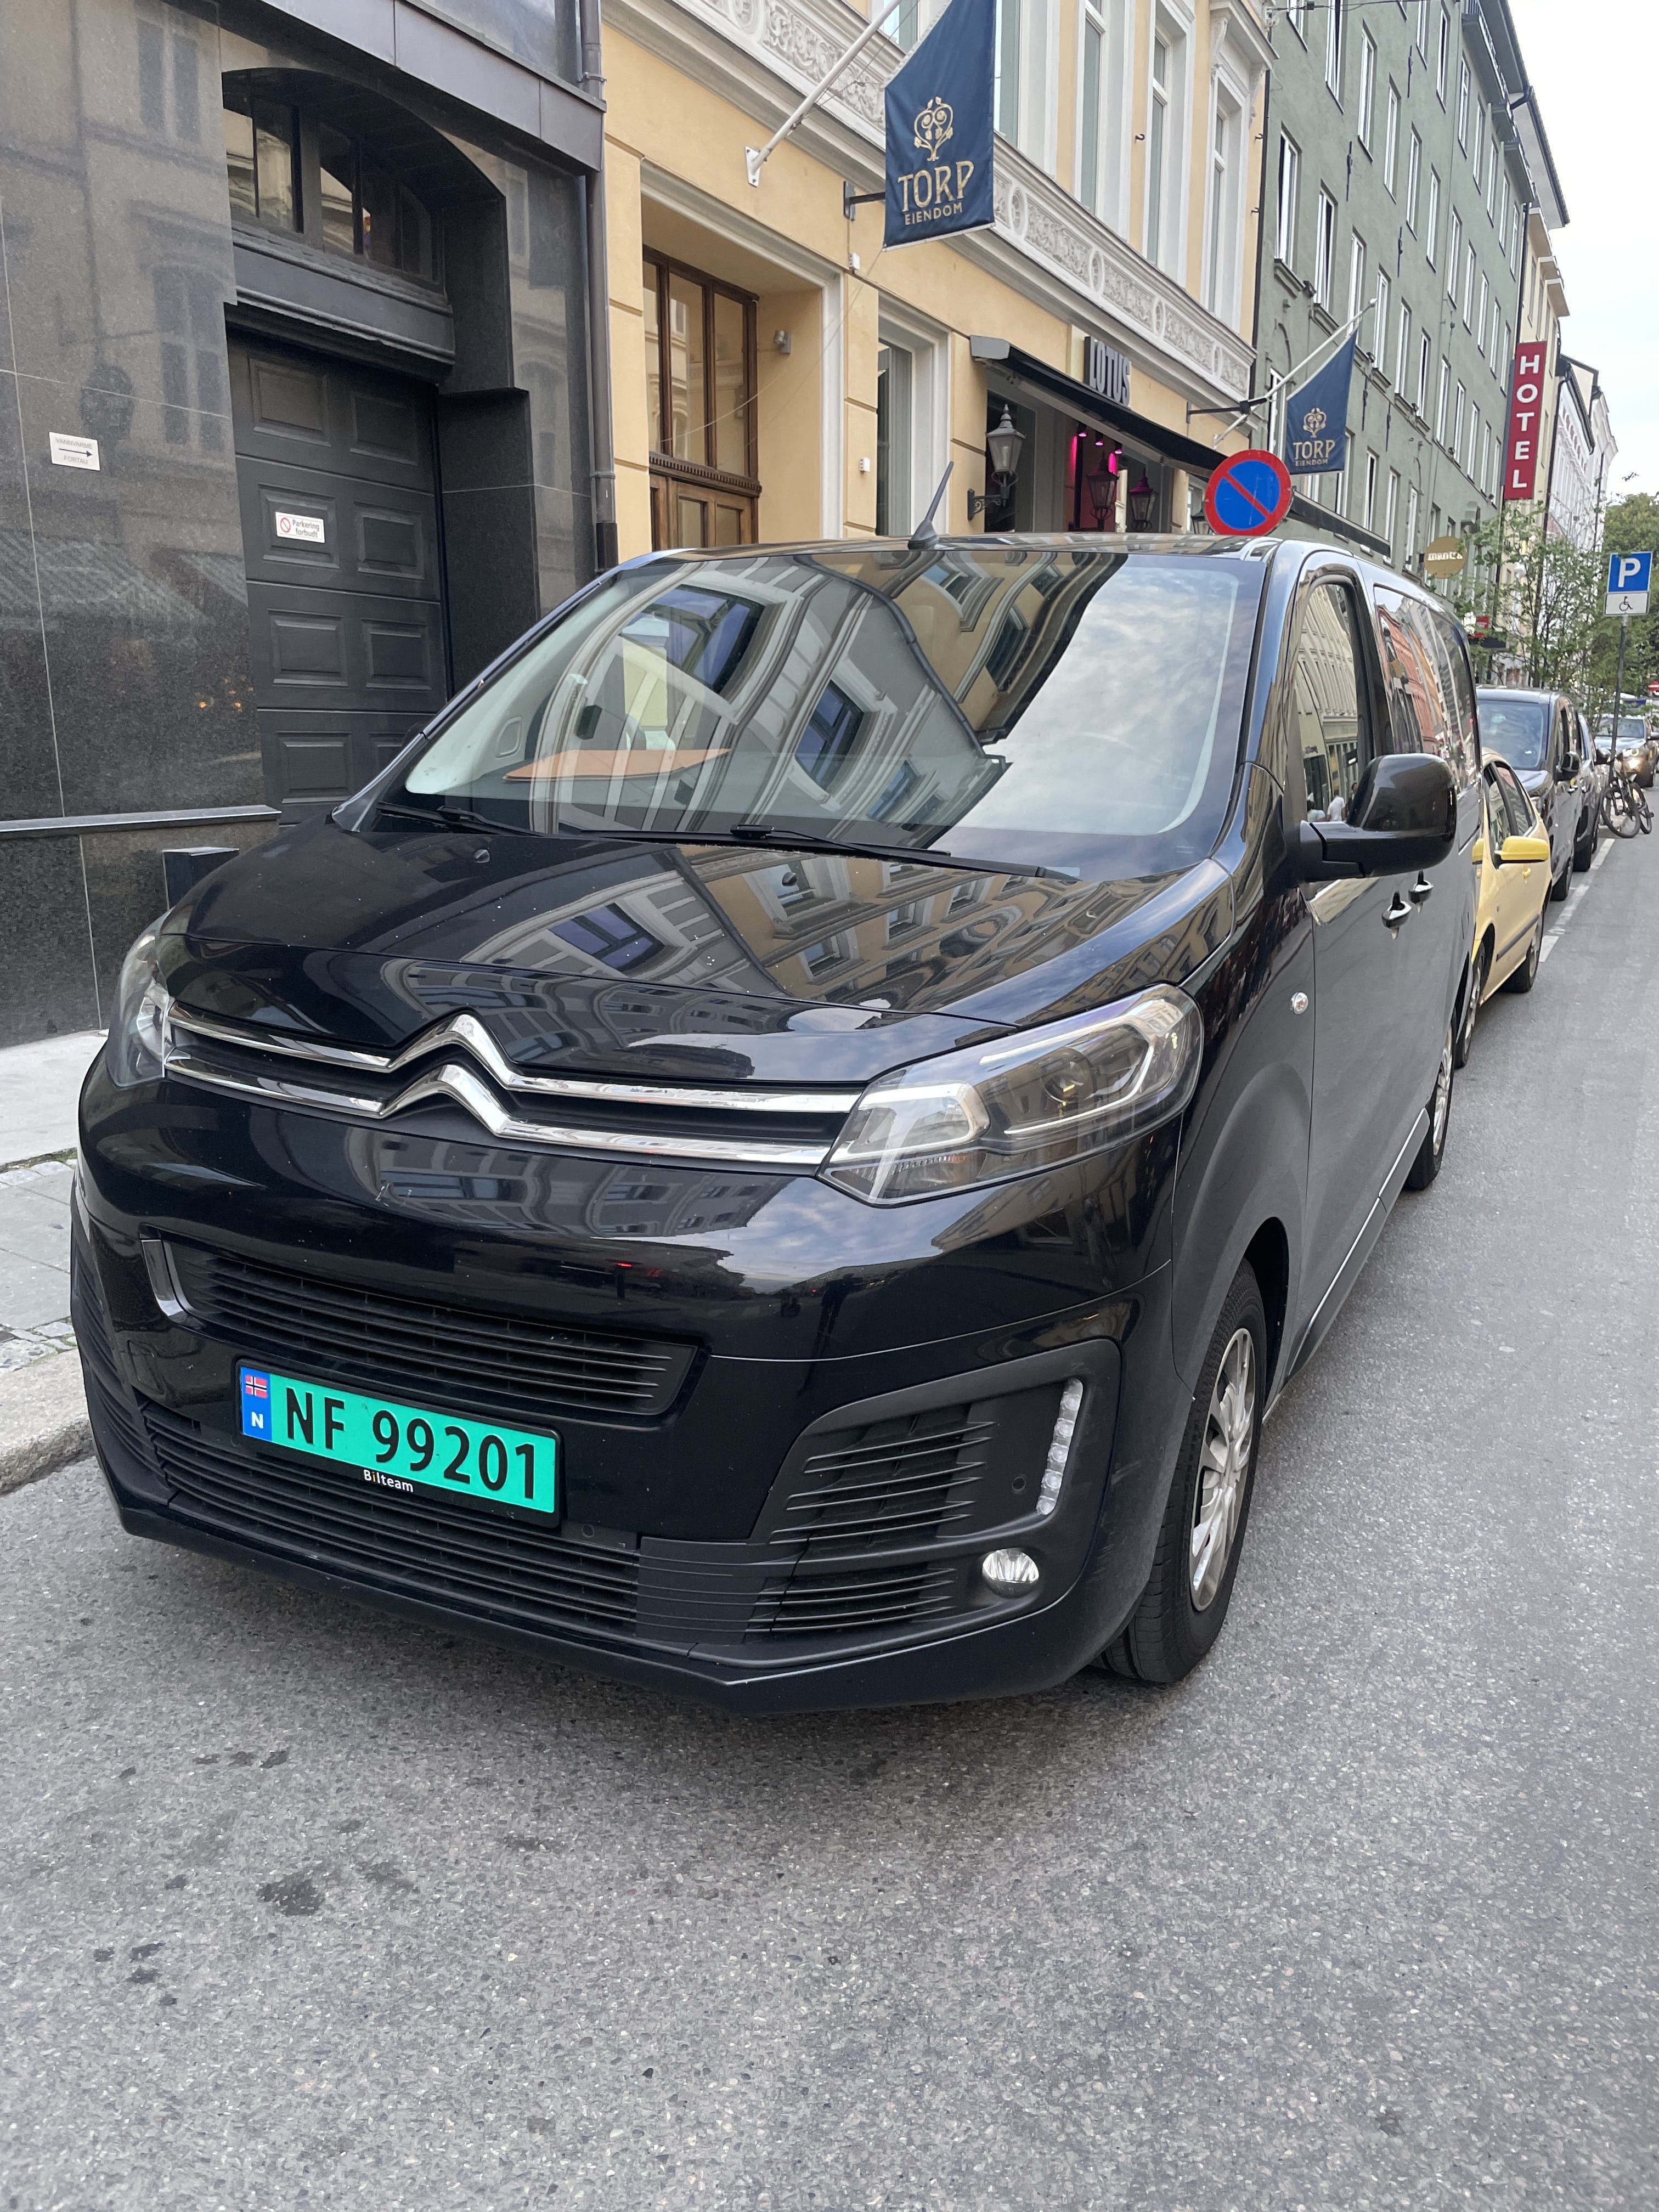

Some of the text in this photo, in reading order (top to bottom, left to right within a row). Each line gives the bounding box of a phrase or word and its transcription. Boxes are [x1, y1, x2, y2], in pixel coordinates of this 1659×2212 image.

[898, 160, 974, 212] TORP
[905, 202, 963, 225] EIENDOM
[1087, 336, 1130, 407] LOTUS
[1513, 354, 1540, 488] HOTEL
[1293, 439, 1335, 460] TORP
[292, 519, 319, 532] Parkering
[296, 528, 318, 538] forbudt
[1618, 558, 1641, 588] P
[251, 1412, 264, 1429] N
[286, 1387, 534, 1500] NF 99201
[363, 1469, 414, 1493] Bilteam
